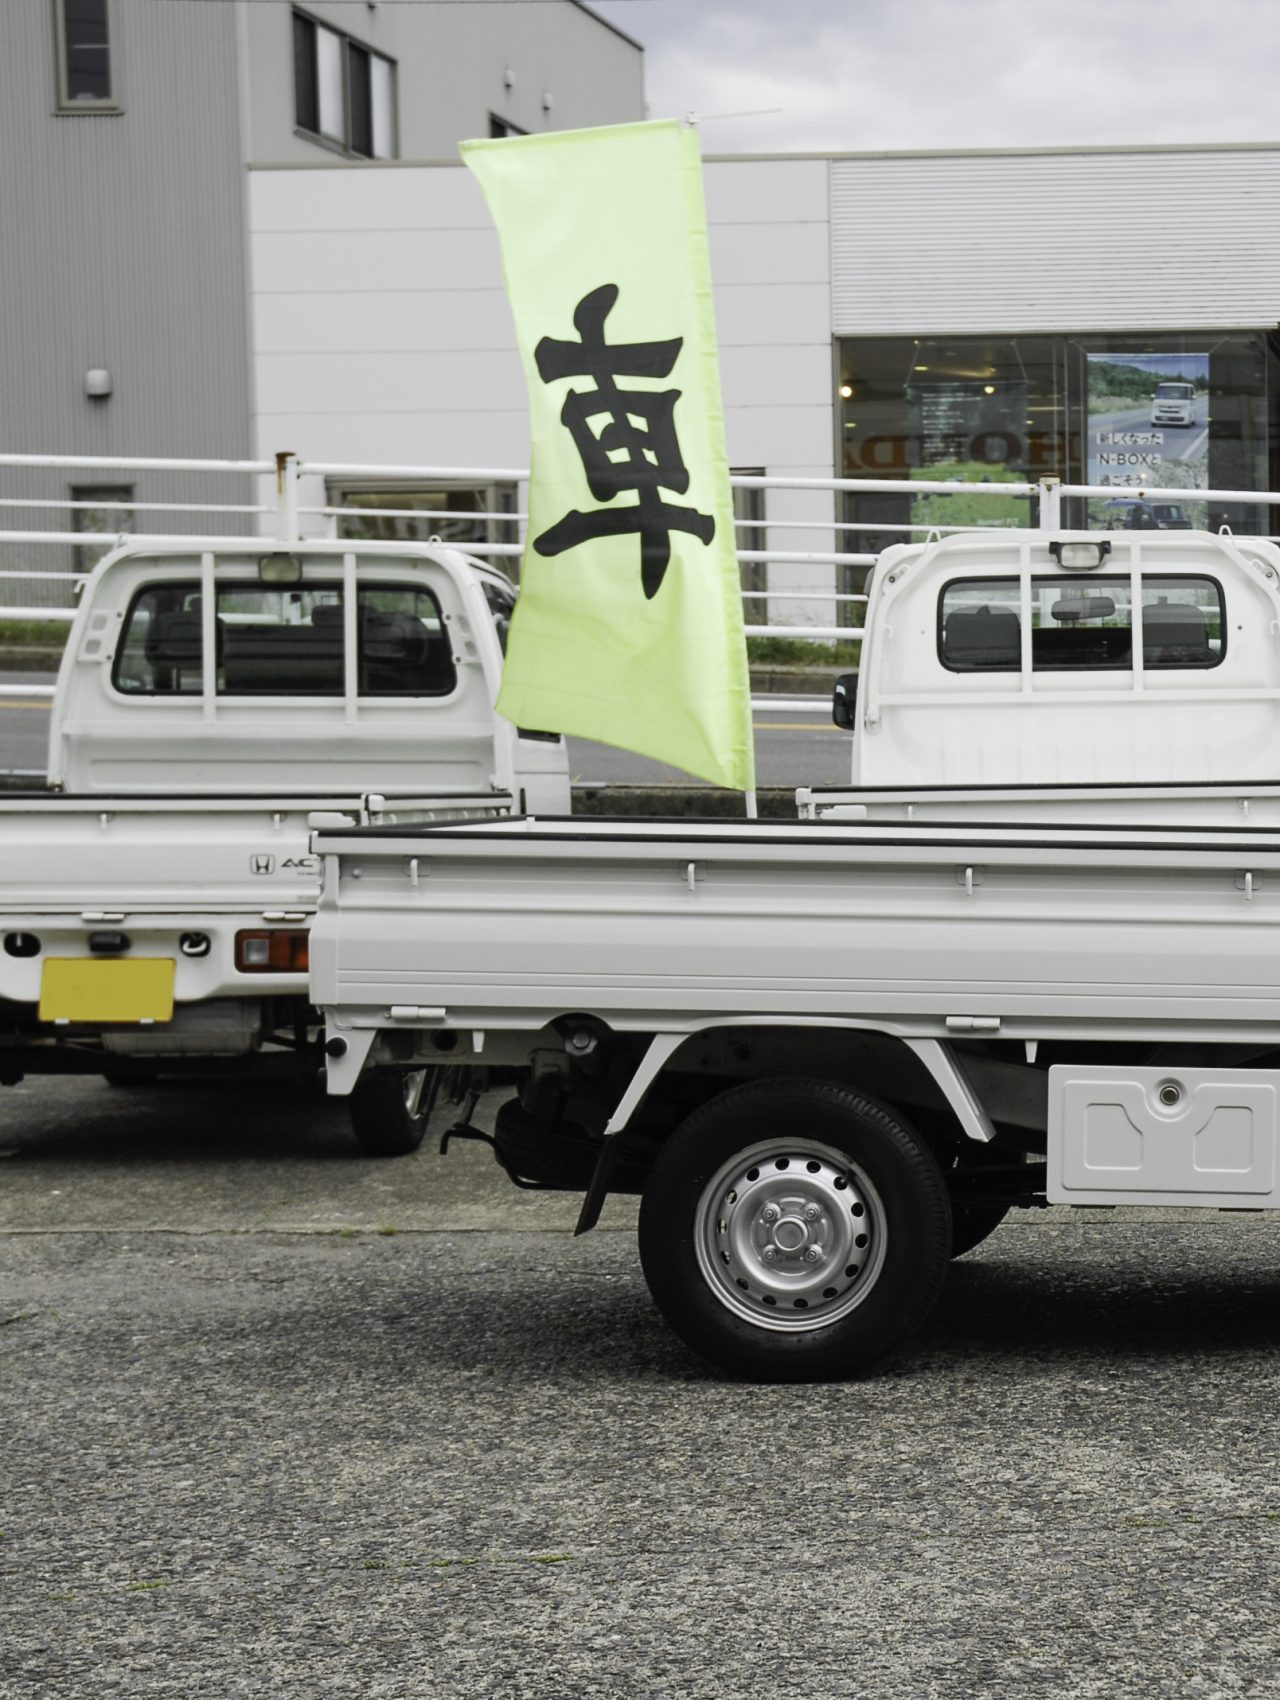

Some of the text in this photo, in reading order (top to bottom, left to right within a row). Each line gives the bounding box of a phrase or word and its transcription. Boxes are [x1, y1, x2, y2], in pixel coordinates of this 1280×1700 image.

[534, 283, 716, 600] 車
[1100, 432, 1161, 445] 新しくなった
[1099, 453, 1159, 466] N-BOXと
